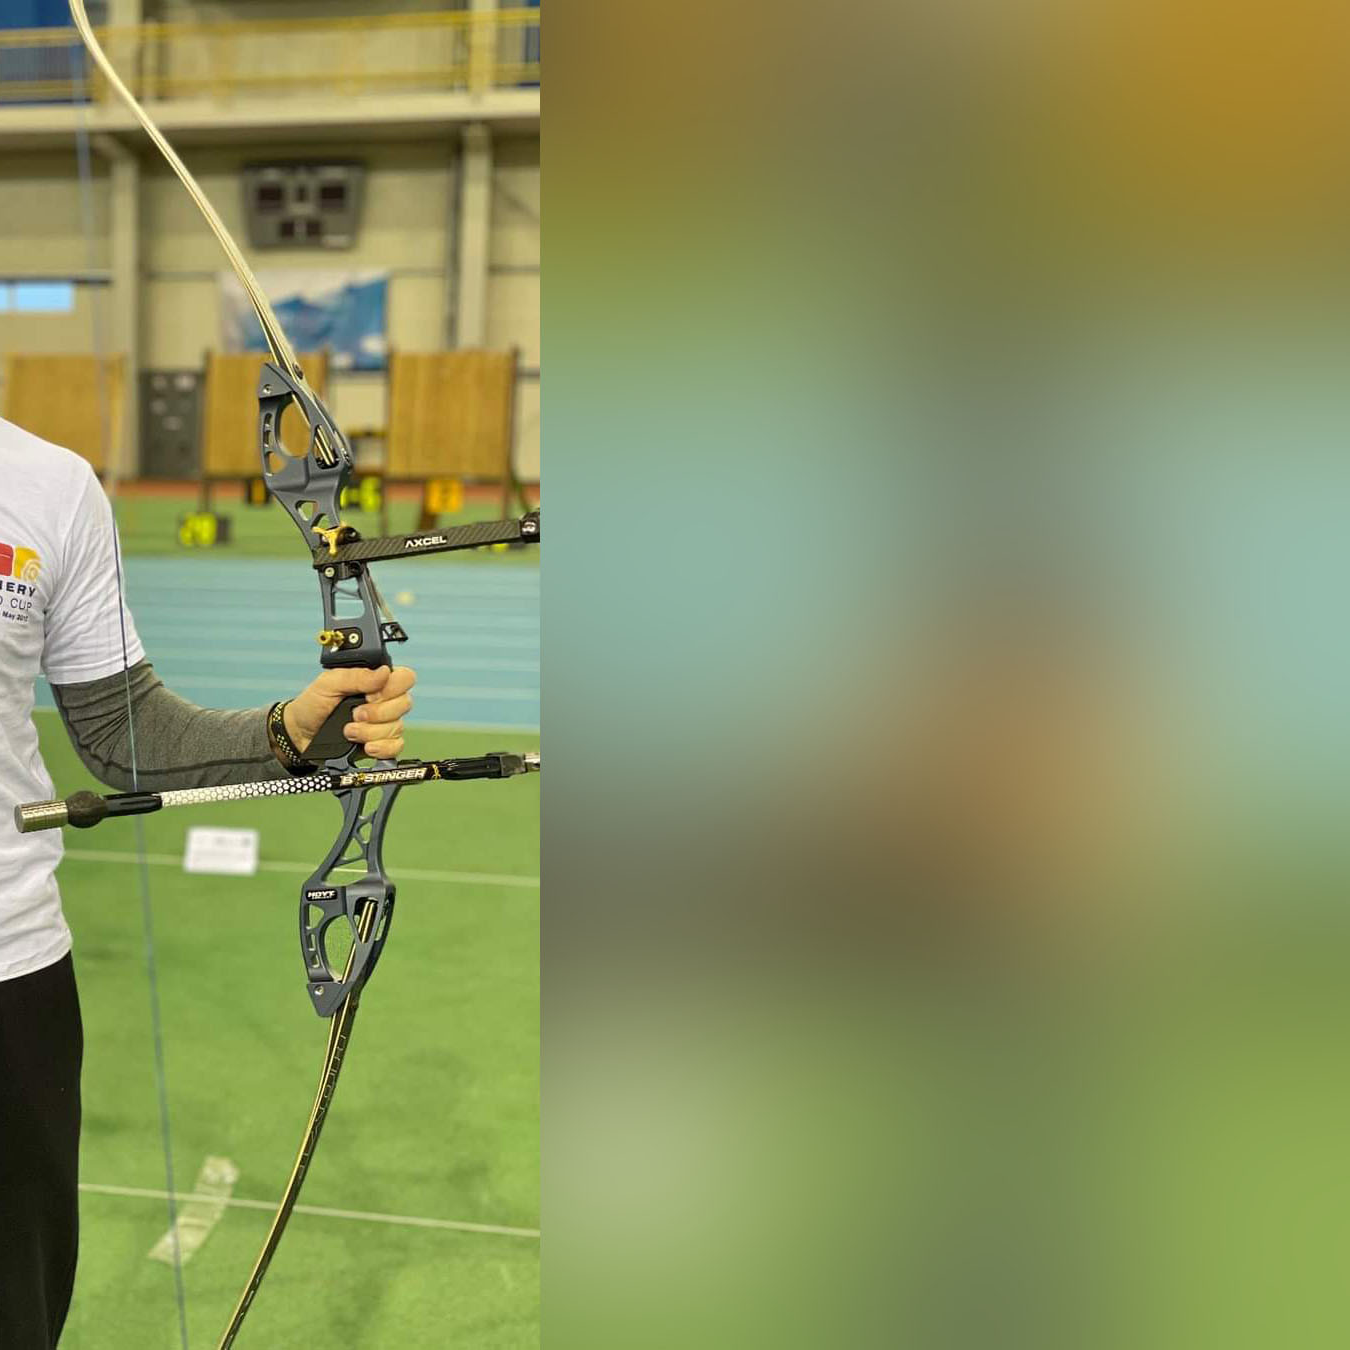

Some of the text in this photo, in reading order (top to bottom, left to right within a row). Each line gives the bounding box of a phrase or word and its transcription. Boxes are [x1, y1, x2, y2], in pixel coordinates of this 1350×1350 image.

[405, 536, 447, 548] AXCEL
[10, 598, 33, 612] CUP
[2, 611, 16, 621] May
